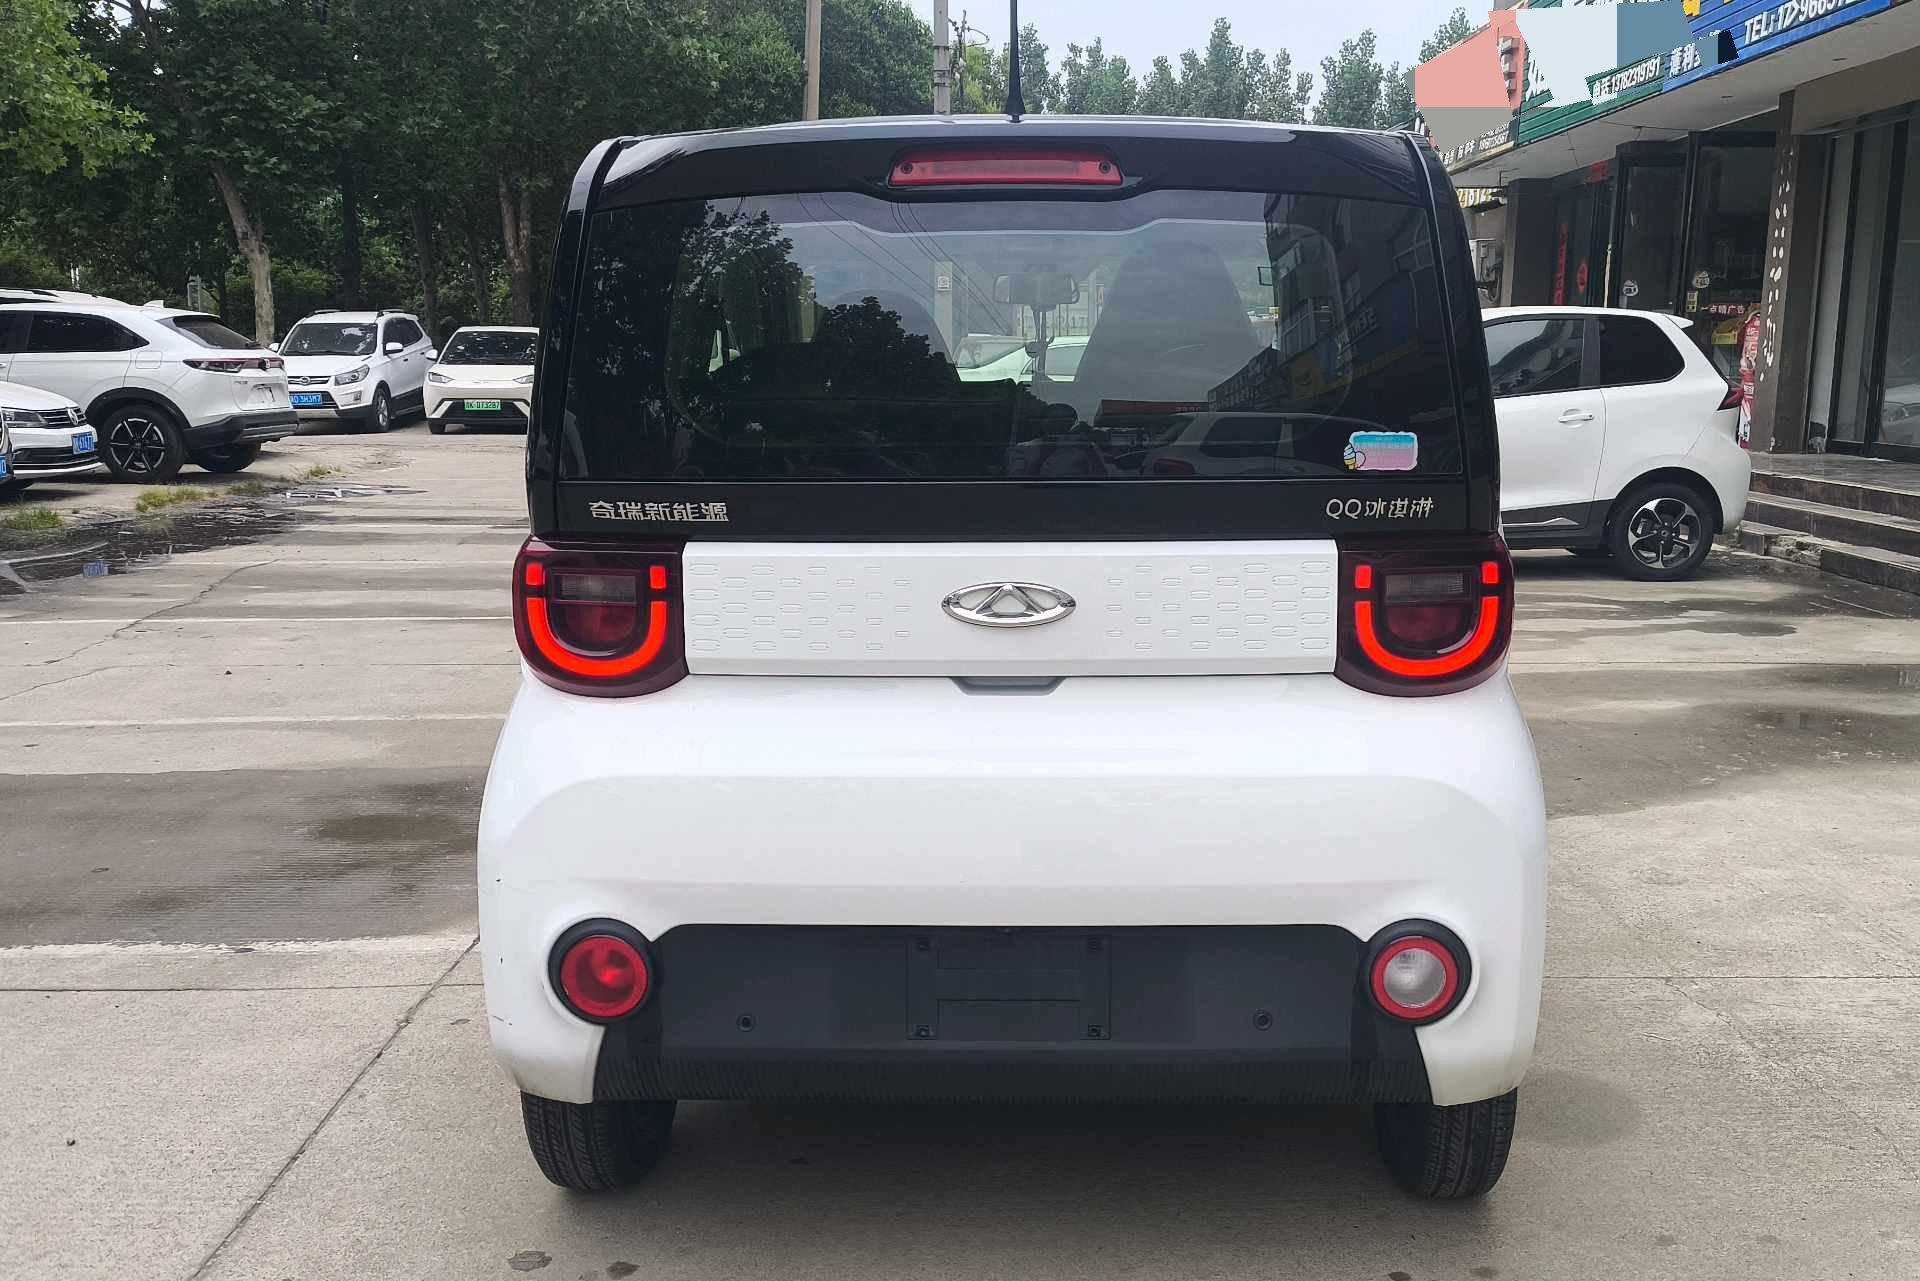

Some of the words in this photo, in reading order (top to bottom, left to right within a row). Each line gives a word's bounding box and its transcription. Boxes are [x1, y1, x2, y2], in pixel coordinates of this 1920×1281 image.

[588, 500, 729, 522] 奇瑞新能源
[1325, 496, 1434, 520] QQ冰淇淋
